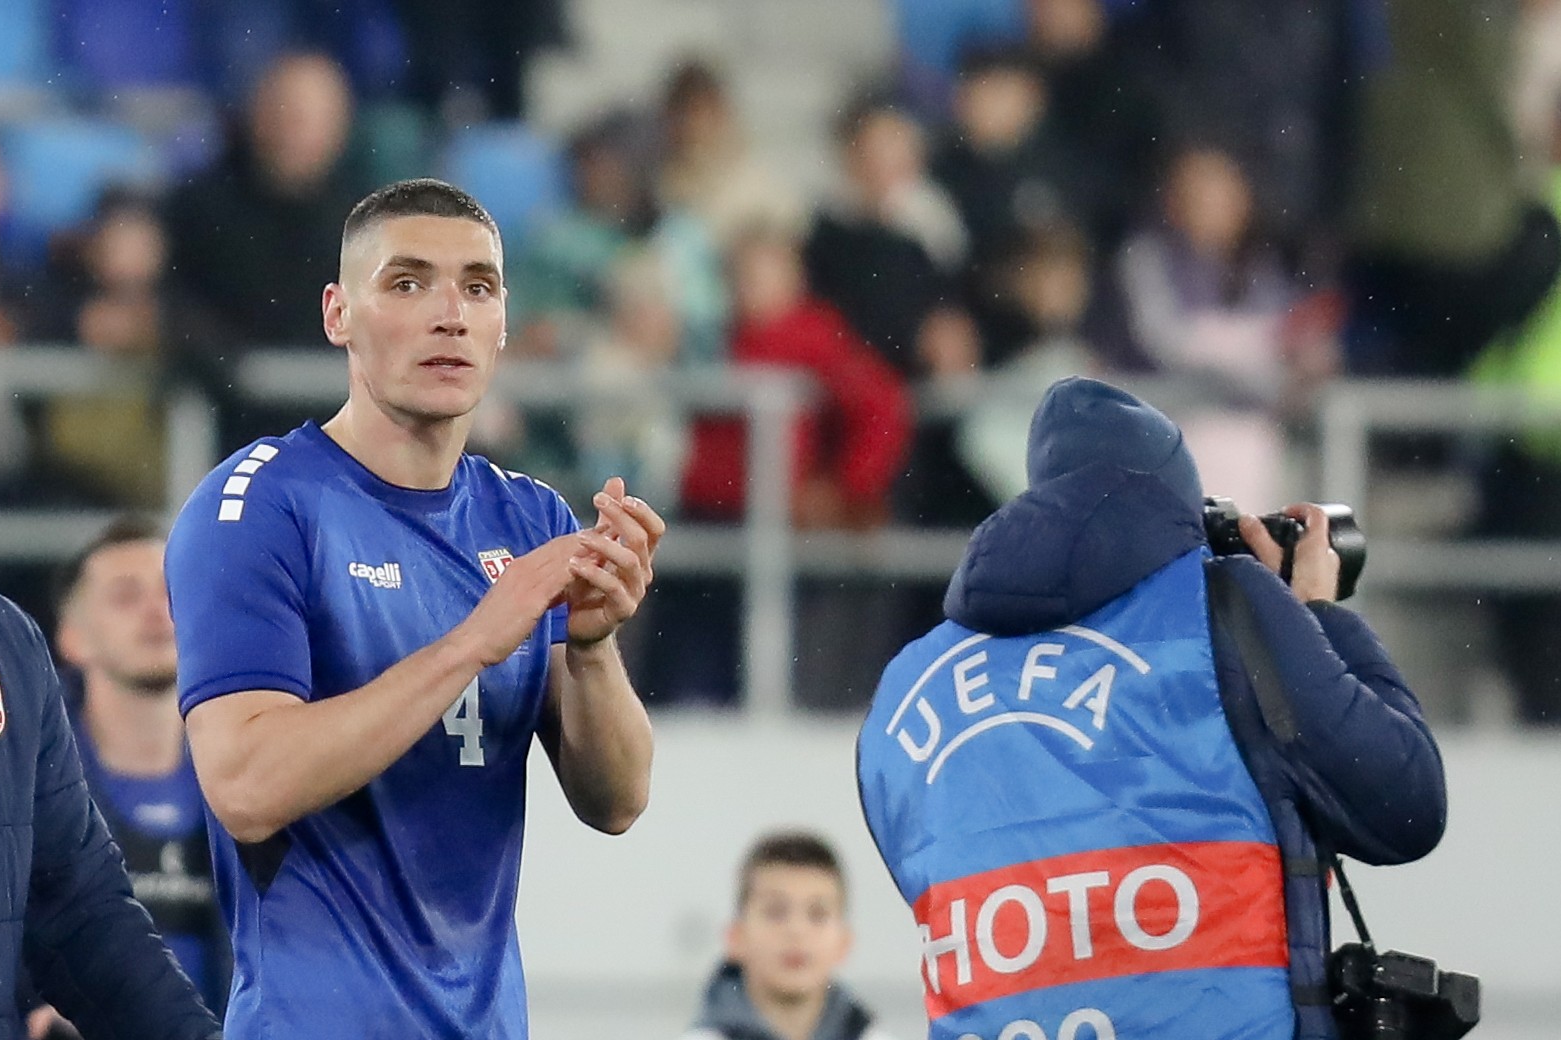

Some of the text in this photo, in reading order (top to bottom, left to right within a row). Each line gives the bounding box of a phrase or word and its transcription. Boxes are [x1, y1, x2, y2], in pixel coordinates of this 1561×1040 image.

[348, 562, 401, 583] capelli
[442, 674, 485, 767] 4
[897, 643, 1116, 762] UEFA
